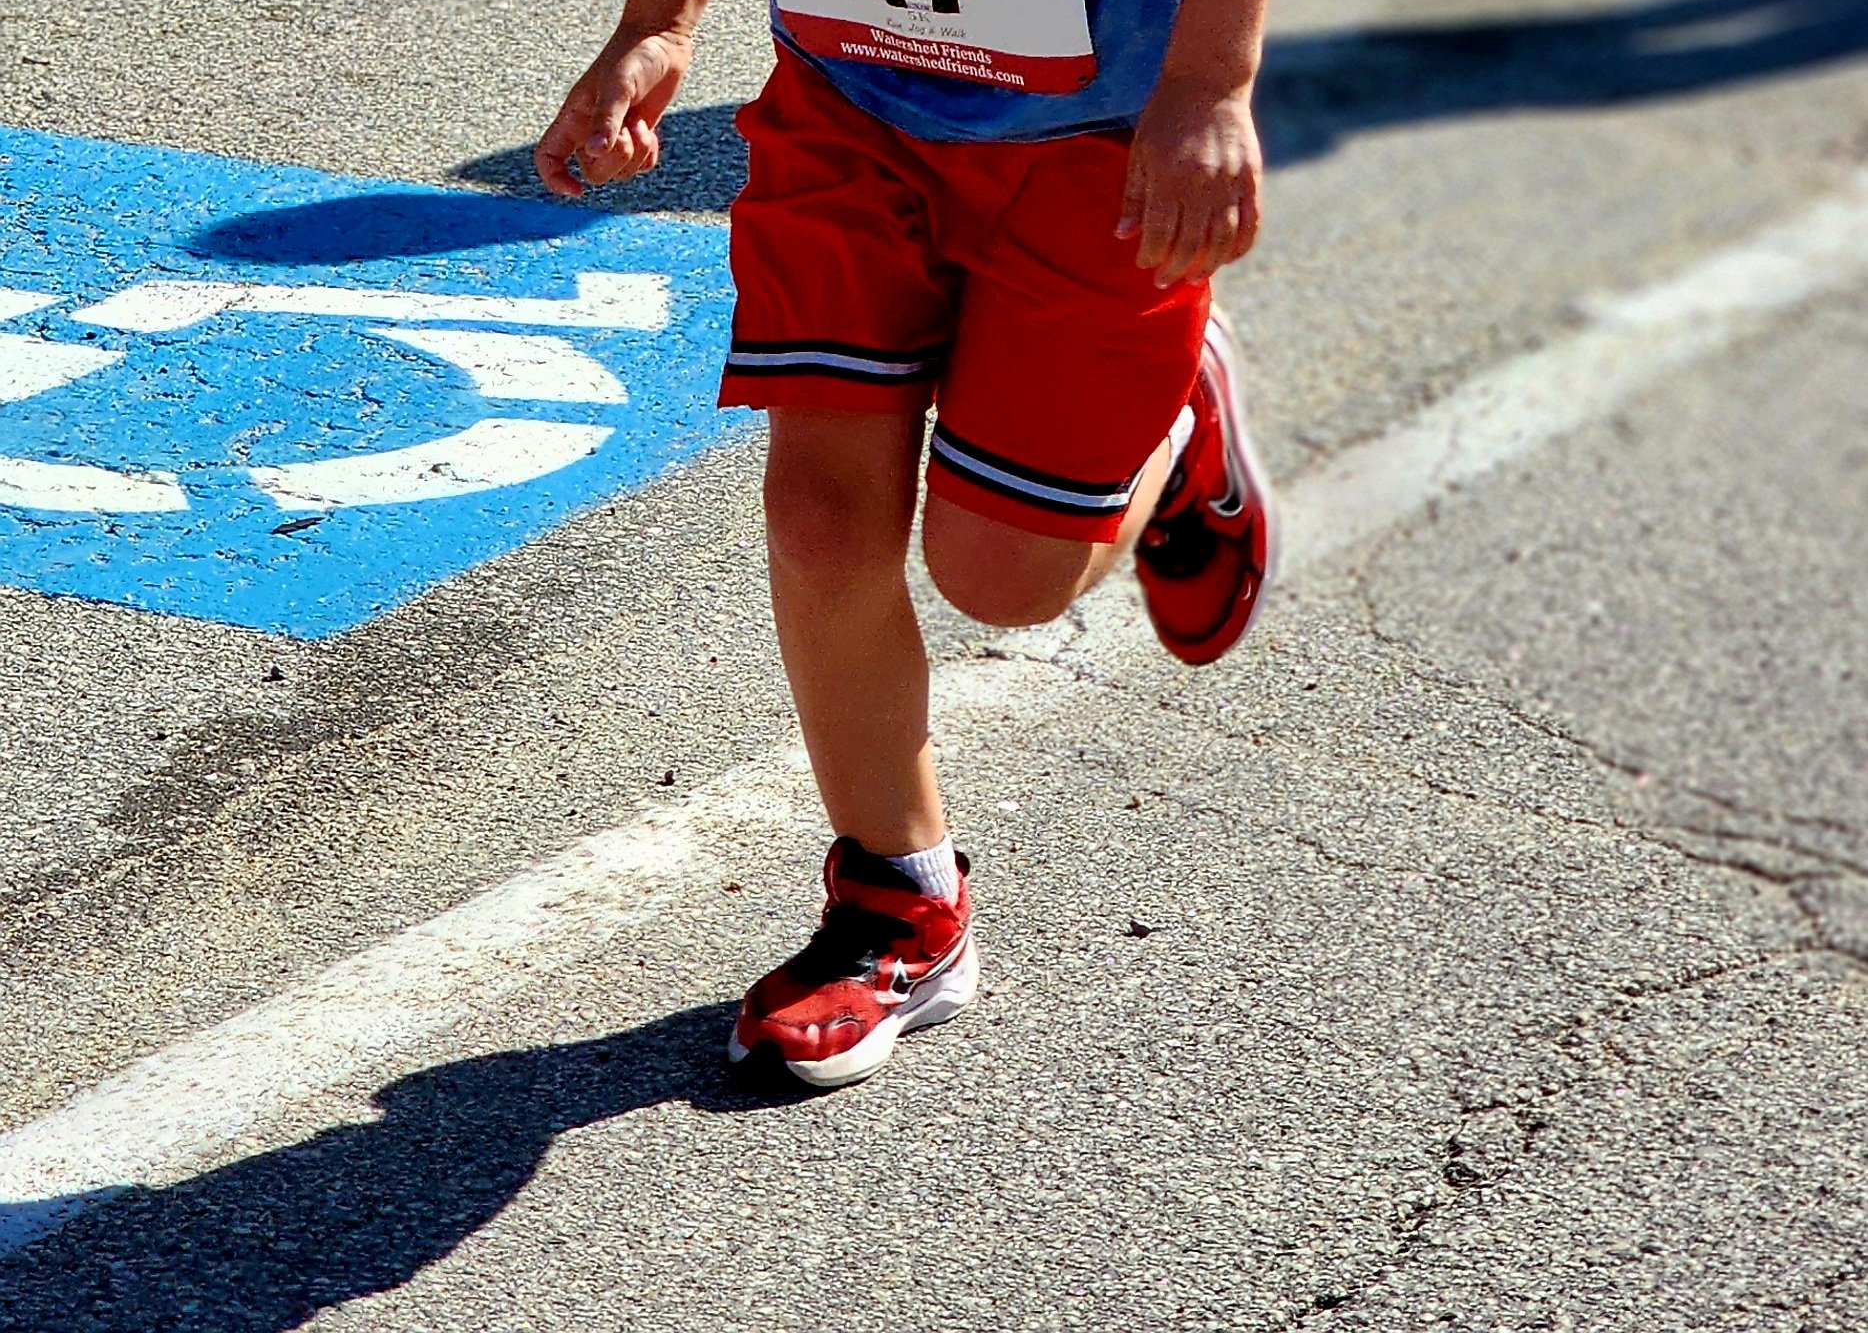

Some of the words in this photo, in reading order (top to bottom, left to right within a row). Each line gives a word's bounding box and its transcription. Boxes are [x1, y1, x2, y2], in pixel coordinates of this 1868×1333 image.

[840, 41, 1026, 87] www.watershedfriends.com
[870, 28, 941, 56] Watershed
[940, 44, 993, 65] Friends
